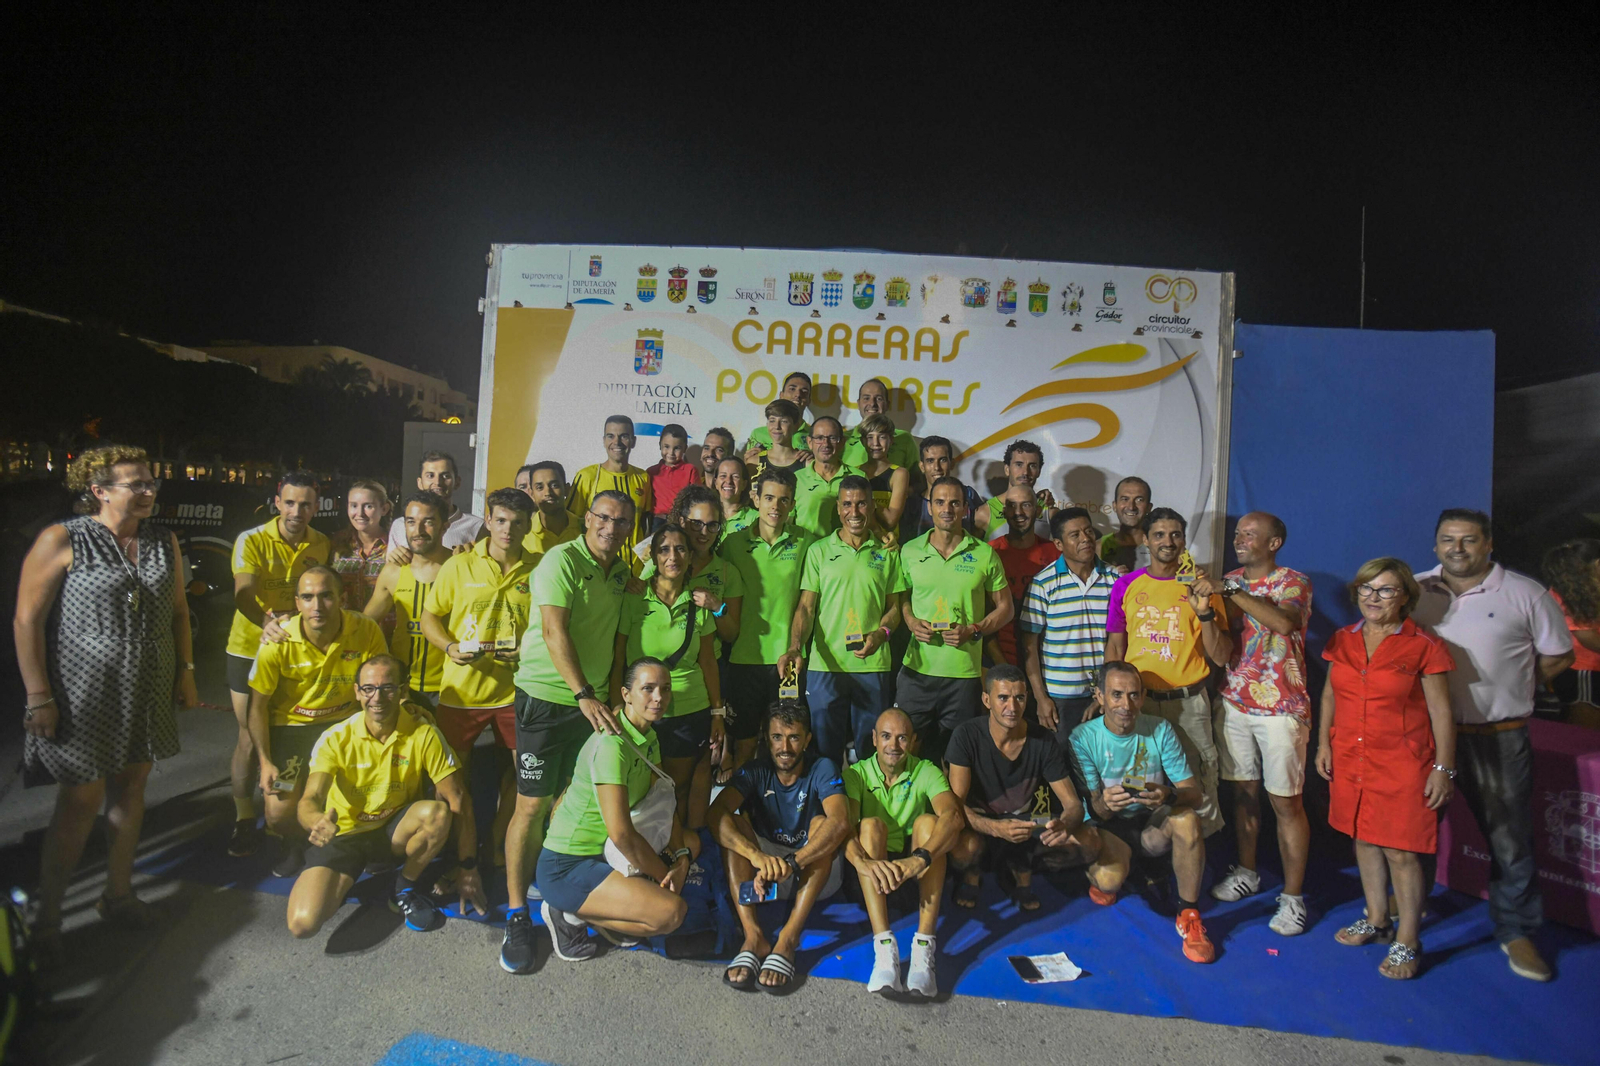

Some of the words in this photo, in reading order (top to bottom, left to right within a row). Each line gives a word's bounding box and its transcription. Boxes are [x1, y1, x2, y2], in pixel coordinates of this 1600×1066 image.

[583, 287, 615, 295] ALMERÍA
[1095, 309, 1122, 323] Gádor
[1149, 313, 1191, 325] circuitos
[732, 319, 970, 363] CARRERAS
[598, 382, 697, 399] DIPUTACIÓN
[715, 369, 981, 415] POULARES
[635, 400, 693, 415] LMERÍA
[1136, 606, 1185, 641] 21
